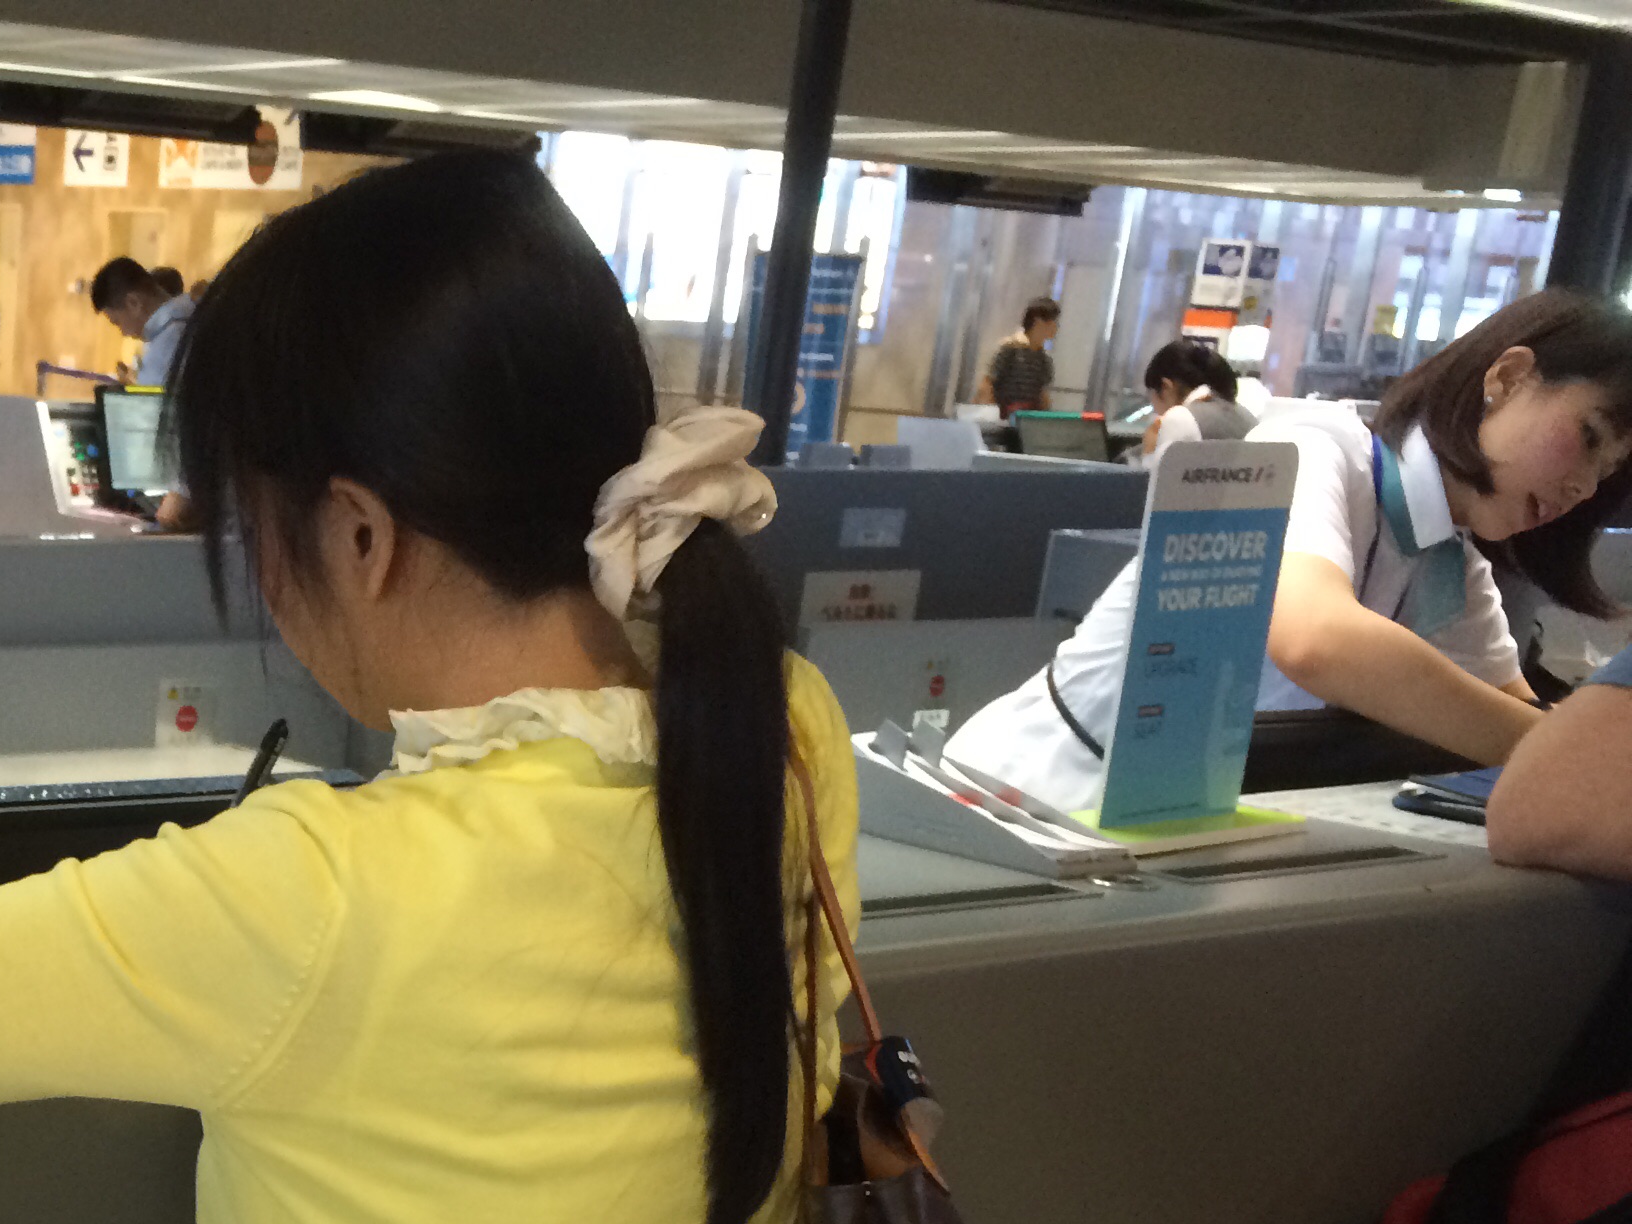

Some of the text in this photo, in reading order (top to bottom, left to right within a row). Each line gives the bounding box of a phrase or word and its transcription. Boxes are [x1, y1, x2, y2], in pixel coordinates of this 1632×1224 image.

[1163, 530, 1267, 563] DISCOVER
[1157, 584, 1259, 611] YOUR FLIGHT
